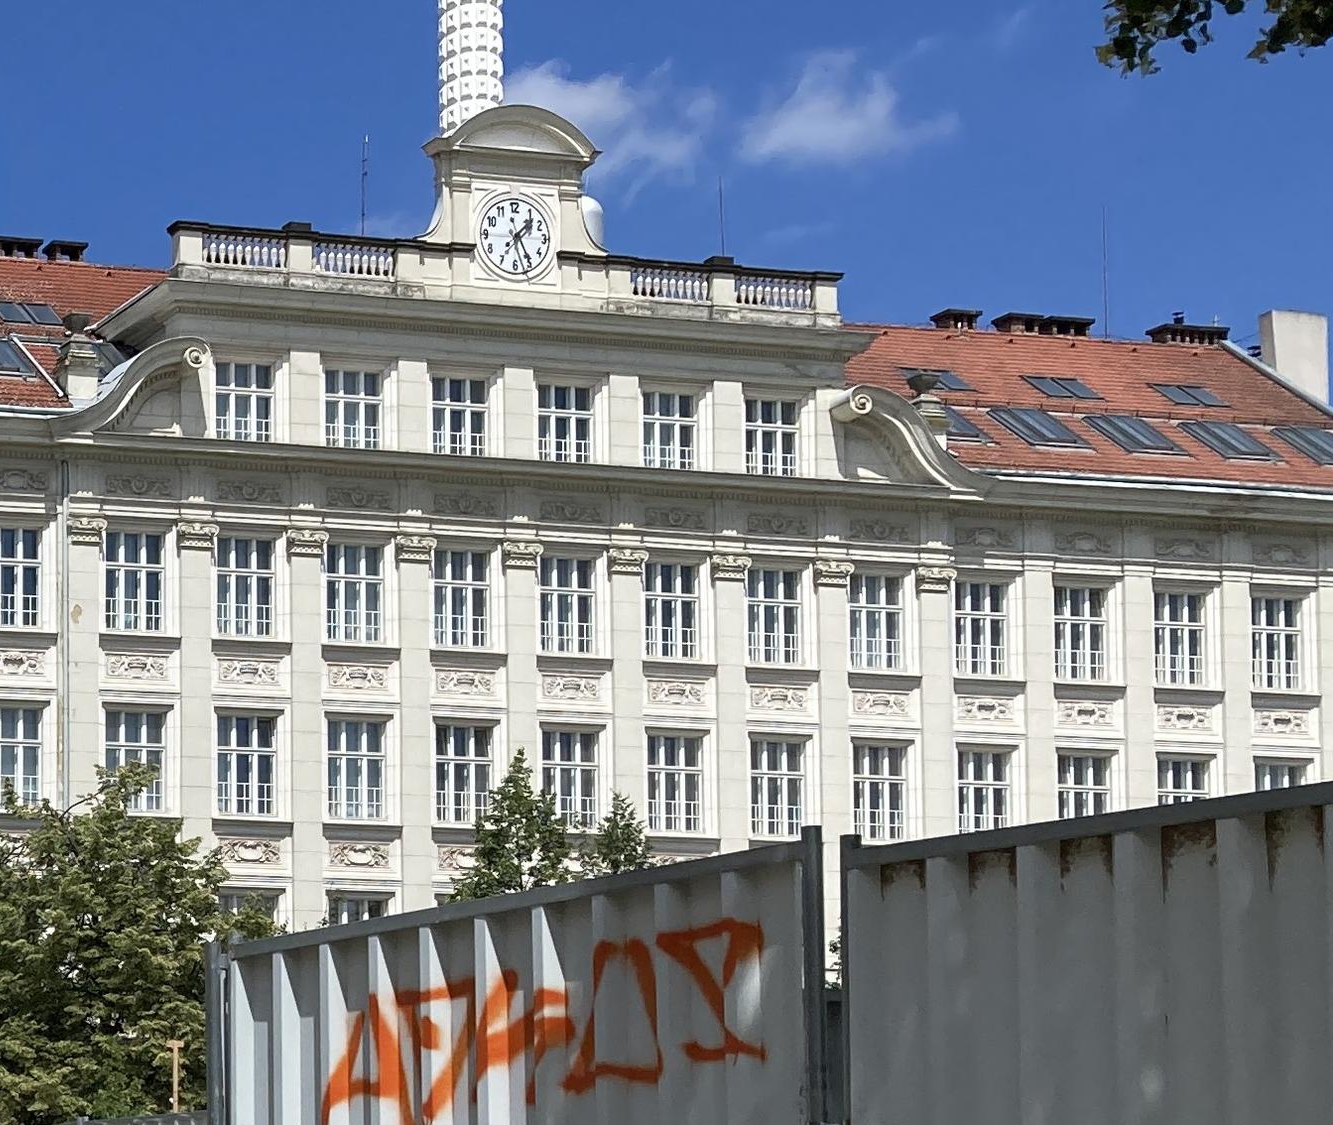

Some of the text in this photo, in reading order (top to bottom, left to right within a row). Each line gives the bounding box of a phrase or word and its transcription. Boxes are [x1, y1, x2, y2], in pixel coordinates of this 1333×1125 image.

[497, 206, 505, 217] 11
[509, 202, 519, 213] 12
[487, 216, 496, 227] 10
[537, 220, 543, 231] 2
[483, 229, 489, 240] 9
[541, 234, 547, 245] 3
[487, 243, 493, 254] 8
[536, 247, 541, 258] 4
[500, 255, 504, 265] 7
[513, 260, 518, 271] 6
